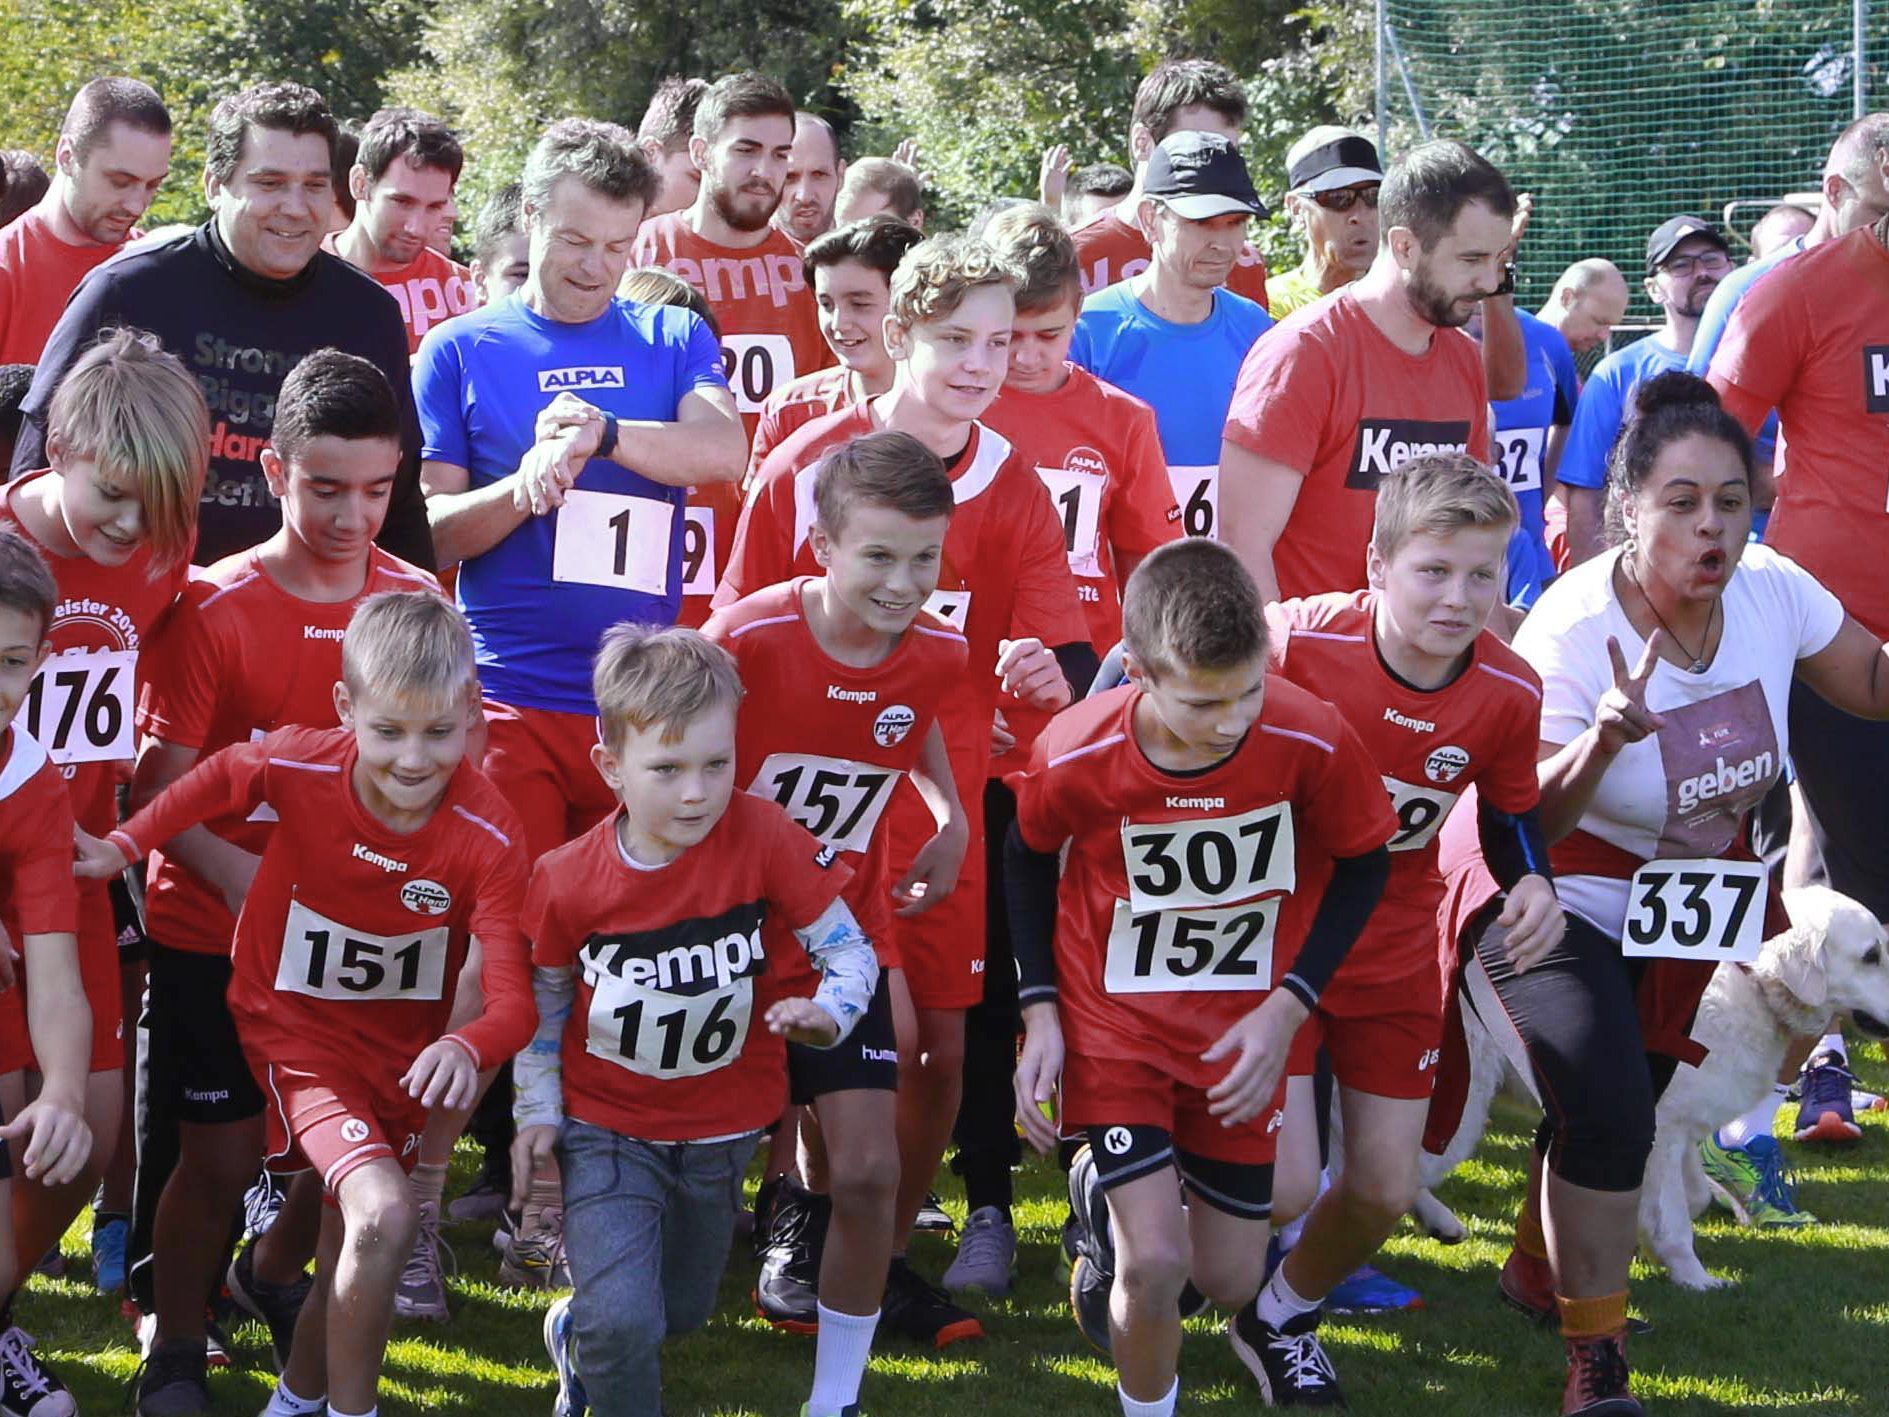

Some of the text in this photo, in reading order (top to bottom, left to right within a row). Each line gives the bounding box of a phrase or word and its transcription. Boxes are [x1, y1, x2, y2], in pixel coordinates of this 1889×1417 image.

[195, 333, 297, 374] Stron
[544, 370, 620, 388] ALPLA
[209, 421, 271, 461] Har
[1059, 485, 1081, 552] 1
[1183, 478, 1213, 537] 6
[608, 509, 631, 576] 1
[682, 519, 707, 584] 9
[27, 667, 122, 747] 176
[827, 685, 876, 704] Kempa
[1383, 707, 1436, 733] Kempa
[772, 766, 891, 840] 157
[1166, 797, 1225, 811] Kempa
[1387, 792, 1441, 836] 9
[1677, 751, 1772, 815] geben
[352, 843, 408, 873] Kempa
[1131, 814, 1281, 897] 307
[1628, 872, 1761, 948] 337
[304, 930, 423, 992] 151
[1131, 911, 1258, 977] 152
[613, 994, 737, 1070] 116
[184, 1087, 229, 1104] Kempa
